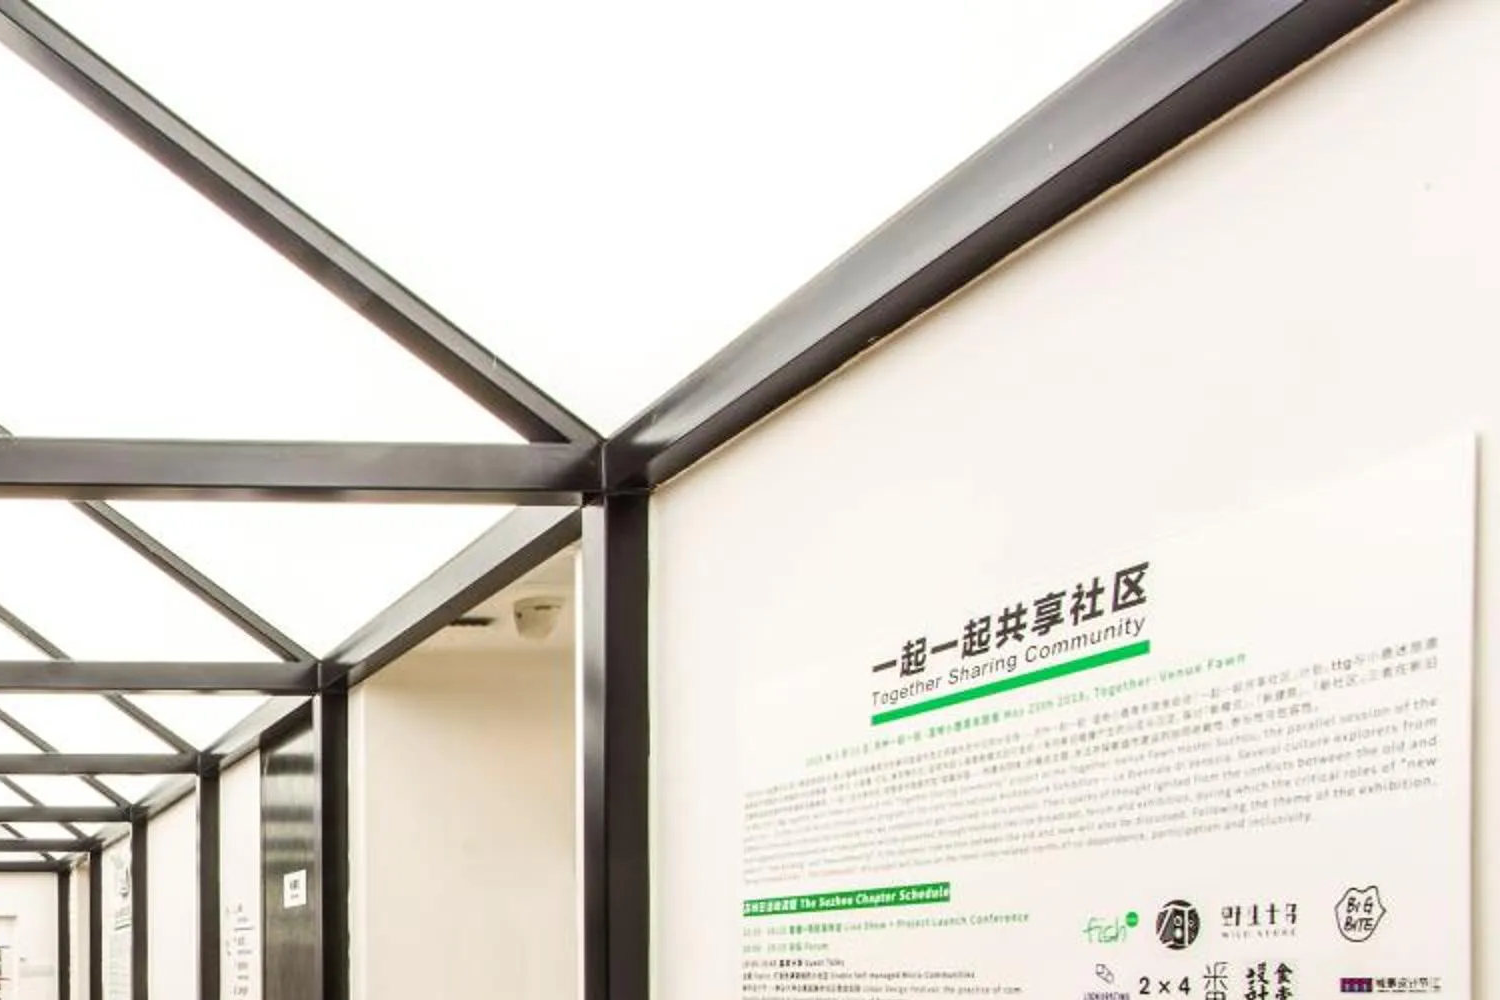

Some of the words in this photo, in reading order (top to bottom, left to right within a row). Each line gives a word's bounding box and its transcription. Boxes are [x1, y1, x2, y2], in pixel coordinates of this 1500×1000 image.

[872, 562, 1150, 678] 一起一起共享社区
[871, 673, 942, 707] Together
[946, 655, 1017, 690] Sharing
[1025, 616, 1147, 664] Community
[899, 883, 949, 902] Schedule
[969, 913, 1029, 925] Conference
[1139, 976, 1150, 996] 2
[1177, 976, 1192, 997] 4
